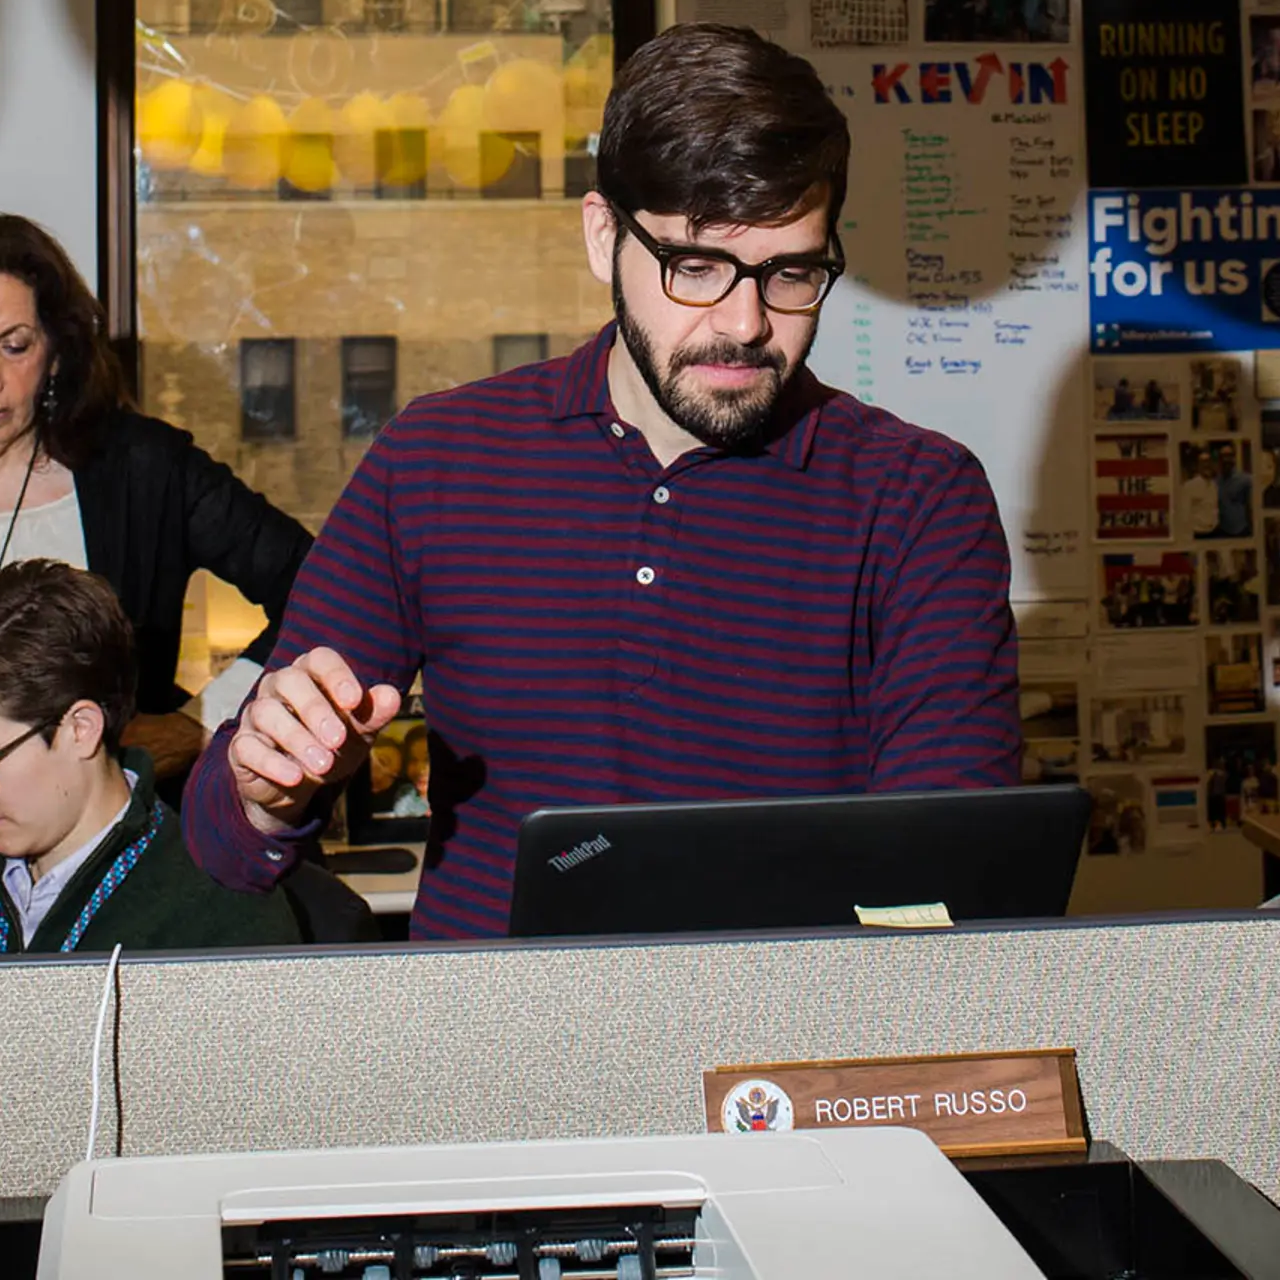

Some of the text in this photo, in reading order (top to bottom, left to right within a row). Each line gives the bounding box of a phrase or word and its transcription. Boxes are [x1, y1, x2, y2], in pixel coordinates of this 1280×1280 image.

[1099, 22, 1225, 57] RUNNING
[871, 52, 1070, 105] KEVIN
[1121, 67, 1207, 101] ON NO
[1126, 112, 1204, 147] SLEEP
[1090, 247, 1173, 297] for
[1184, 258, 1250, 296] us
[1116, 439, 1148, 458] WE
[1117, 477, 1155, 495] THE
[548, 834, 611, 872] ThinkPad
[816, 1089, 1027, 1123] ROBERT RUSSO
